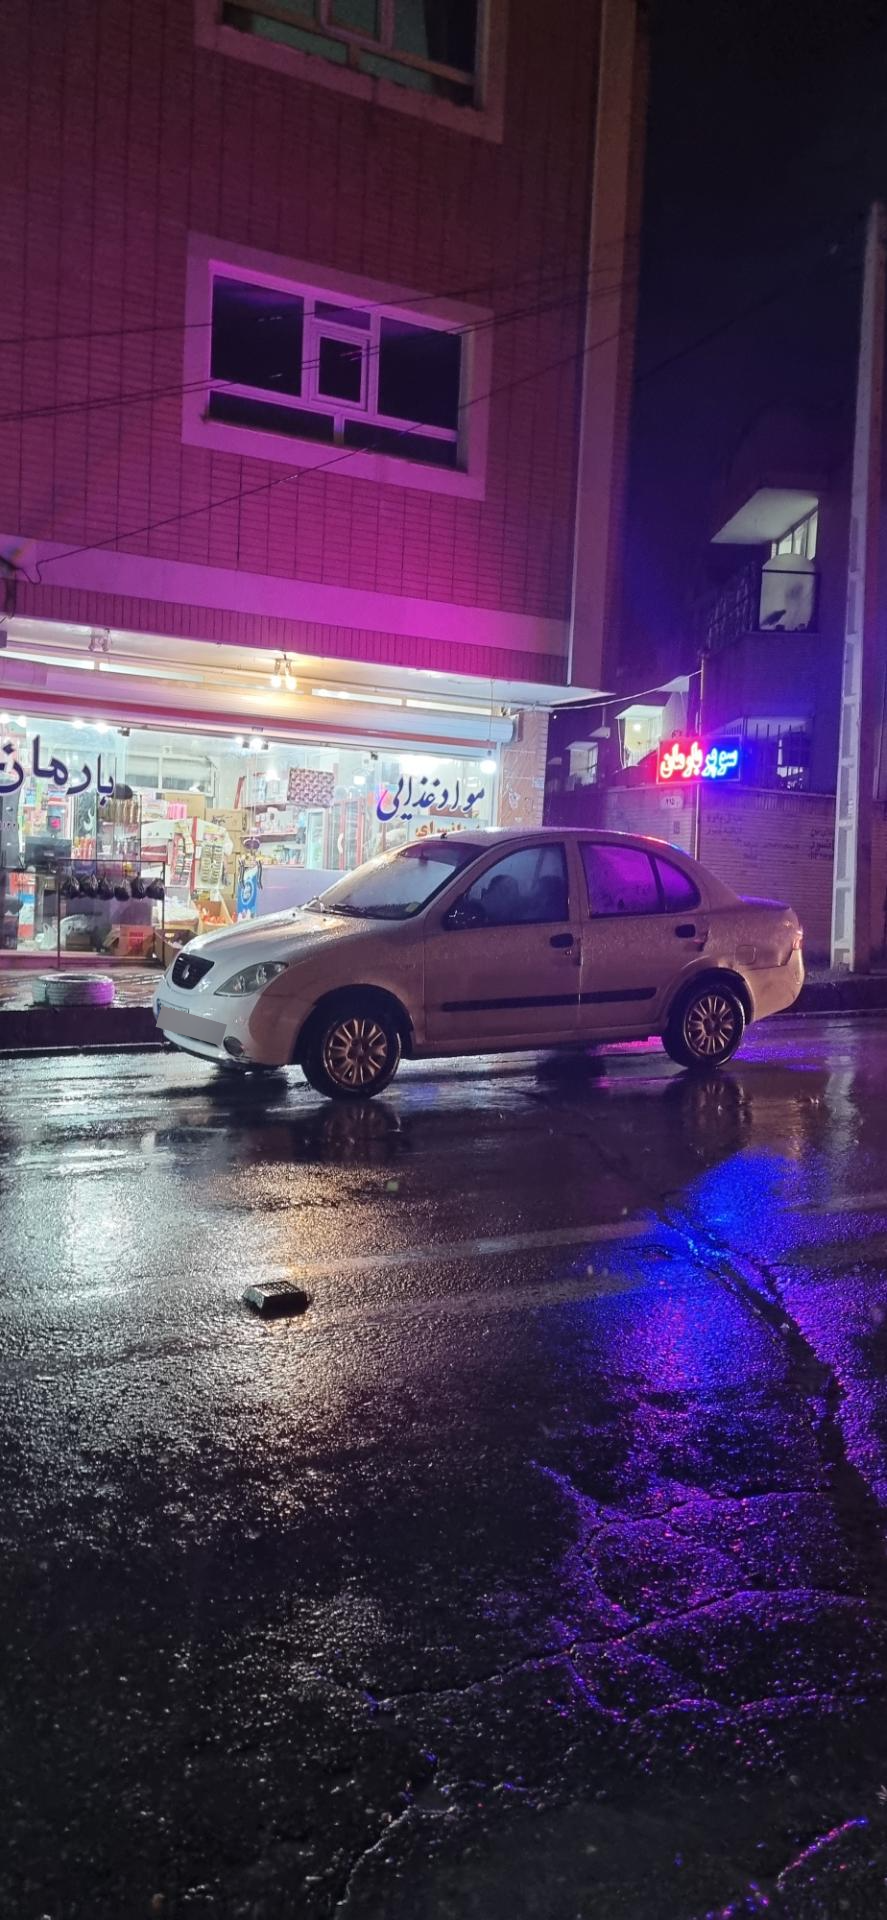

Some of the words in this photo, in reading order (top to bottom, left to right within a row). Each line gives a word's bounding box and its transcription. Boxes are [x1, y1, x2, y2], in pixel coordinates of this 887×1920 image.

[701, 747, 739, 778] سوپر
[376, 776, 440, 821] غذایی
[437, 780, 485, 812] مواد
